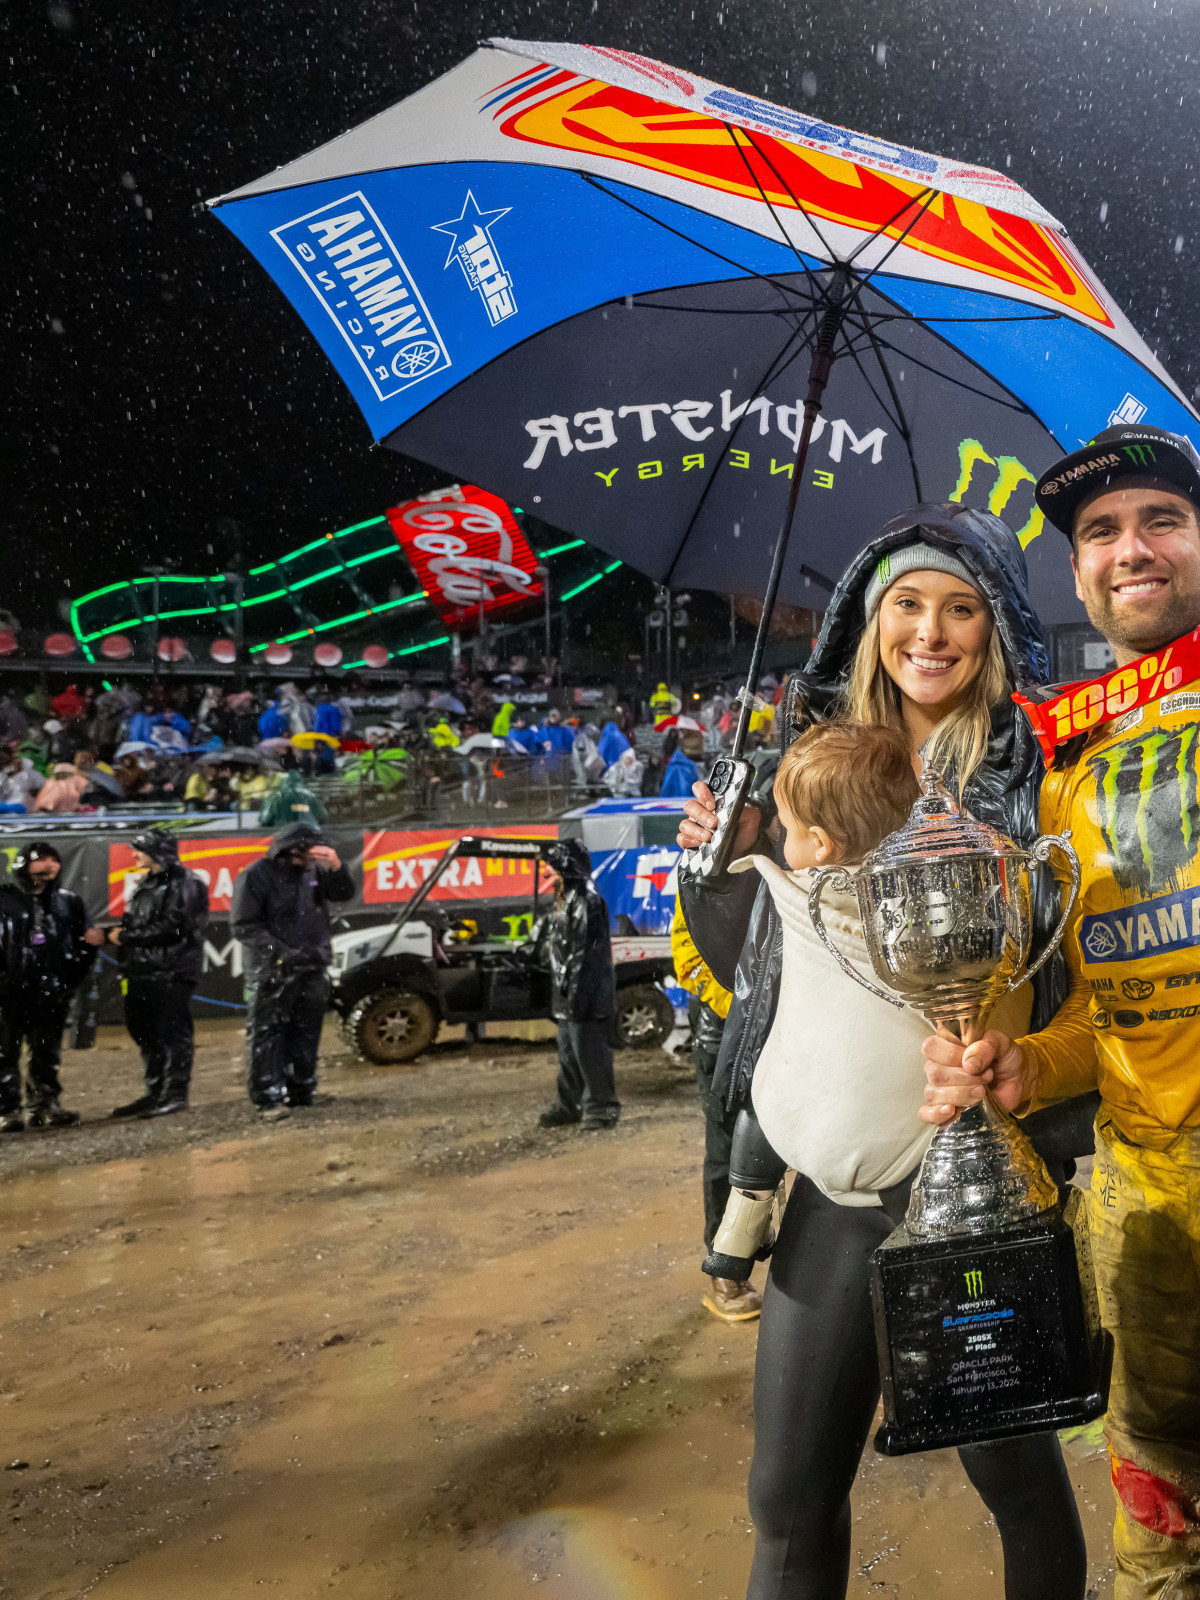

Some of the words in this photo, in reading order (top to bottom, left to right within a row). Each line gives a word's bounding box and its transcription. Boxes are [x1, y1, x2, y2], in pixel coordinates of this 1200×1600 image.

[1054, 453, 1121, 484] YAMAHA
[1048, 648, 1182, 739] 100%
[377, 857, 483, 890] EXTRA
[957, 1299, 996, 1311] MONSTER
[968, 1333, 992, 1344] 250SX
[975, 1342, 997, 1351] Place
[952, 1357, 989, 1371] ORACLE
[989, 1354, 1014, 1365] PARK
[947, 1375, 963, 1385] San
[1009, 1365, 1021, 1374] CA
[951, 1383, 986, 1396] January
[999, 1379, 1020, 1388] 2024
